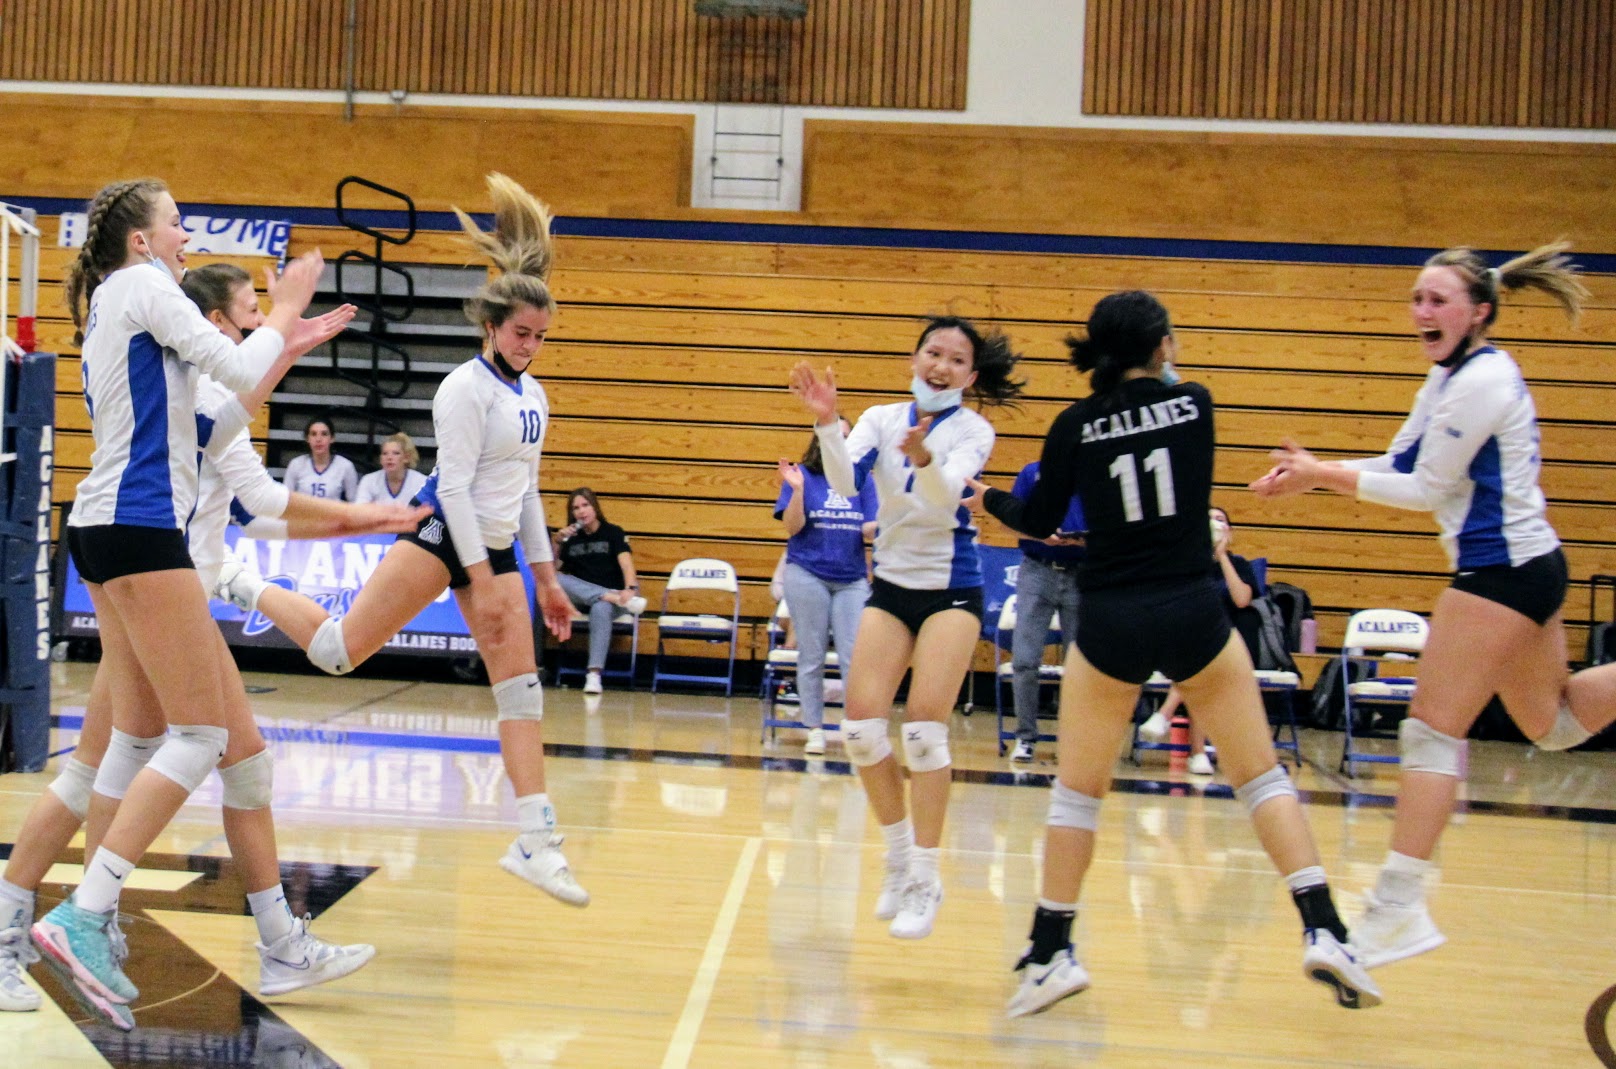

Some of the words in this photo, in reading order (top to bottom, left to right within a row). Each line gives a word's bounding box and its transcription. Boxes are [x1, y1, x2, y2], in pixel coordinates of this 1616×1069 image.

[181, 215, 290, 257] COME
[519, 409, 541, 444] 10
[1081, 395, 1200, 444] ACALANES
[311, 482, 326, 498] 15
[1108, 447, 1177, 523] 11
[35, 424, 53, 660] ACALANES
[678, 568, 728, 579] ACALANES
[72, 615, 100, 629] ACA
[1357, 621, 1421, 634] ACALANES
[449, 636, 479, 651] BOO
